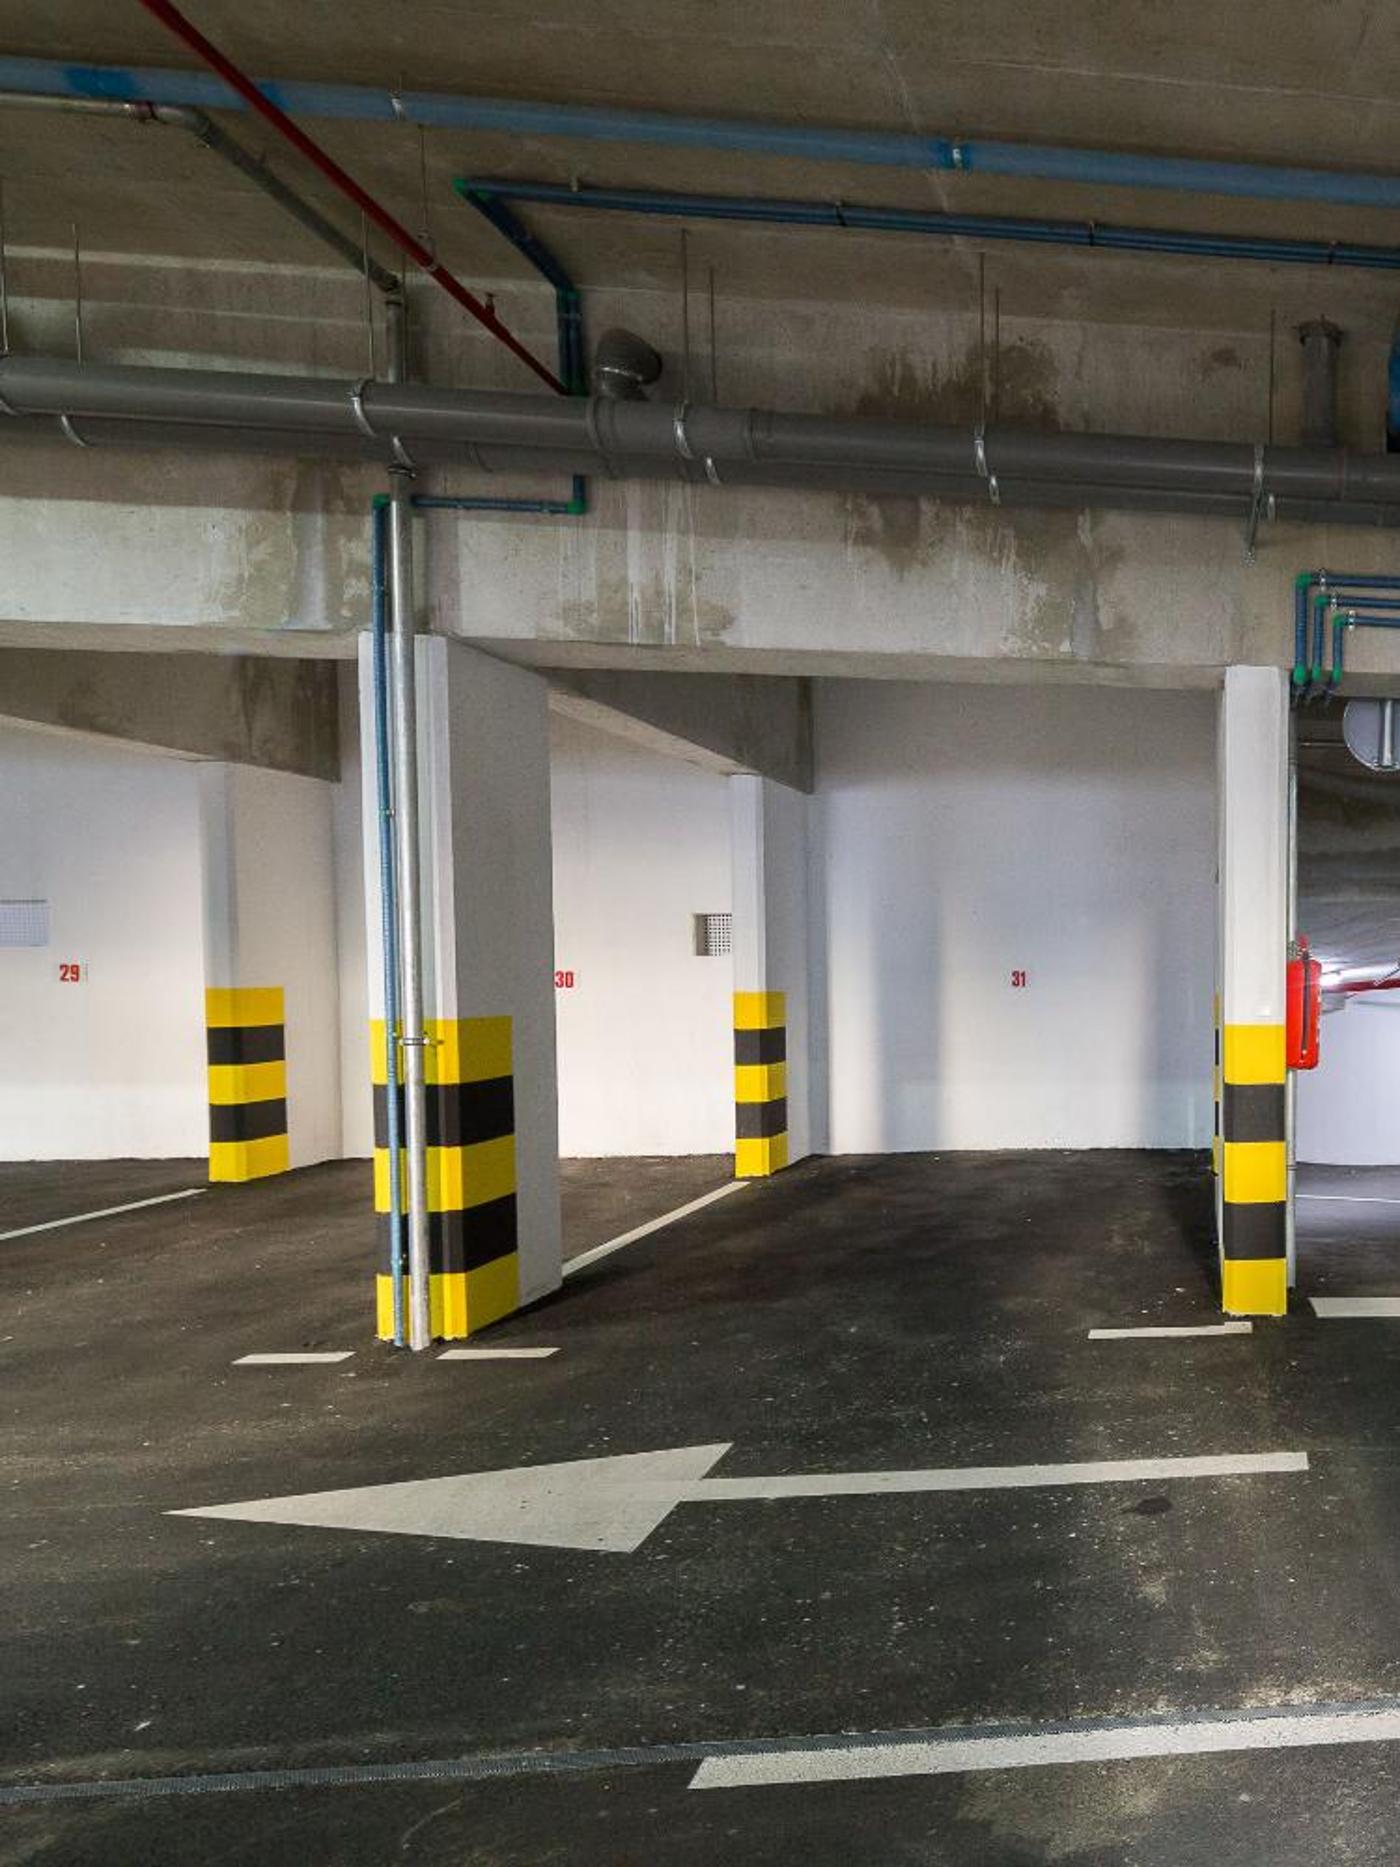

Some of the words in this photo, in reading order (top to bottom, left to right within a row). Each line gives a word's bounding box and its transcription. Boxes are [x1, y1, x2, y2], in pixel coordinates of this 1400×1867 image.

[59, 964, 80, 982] 29
[555, 970, 574, 988] 30
[1011, 970, 1026, 987] 31
